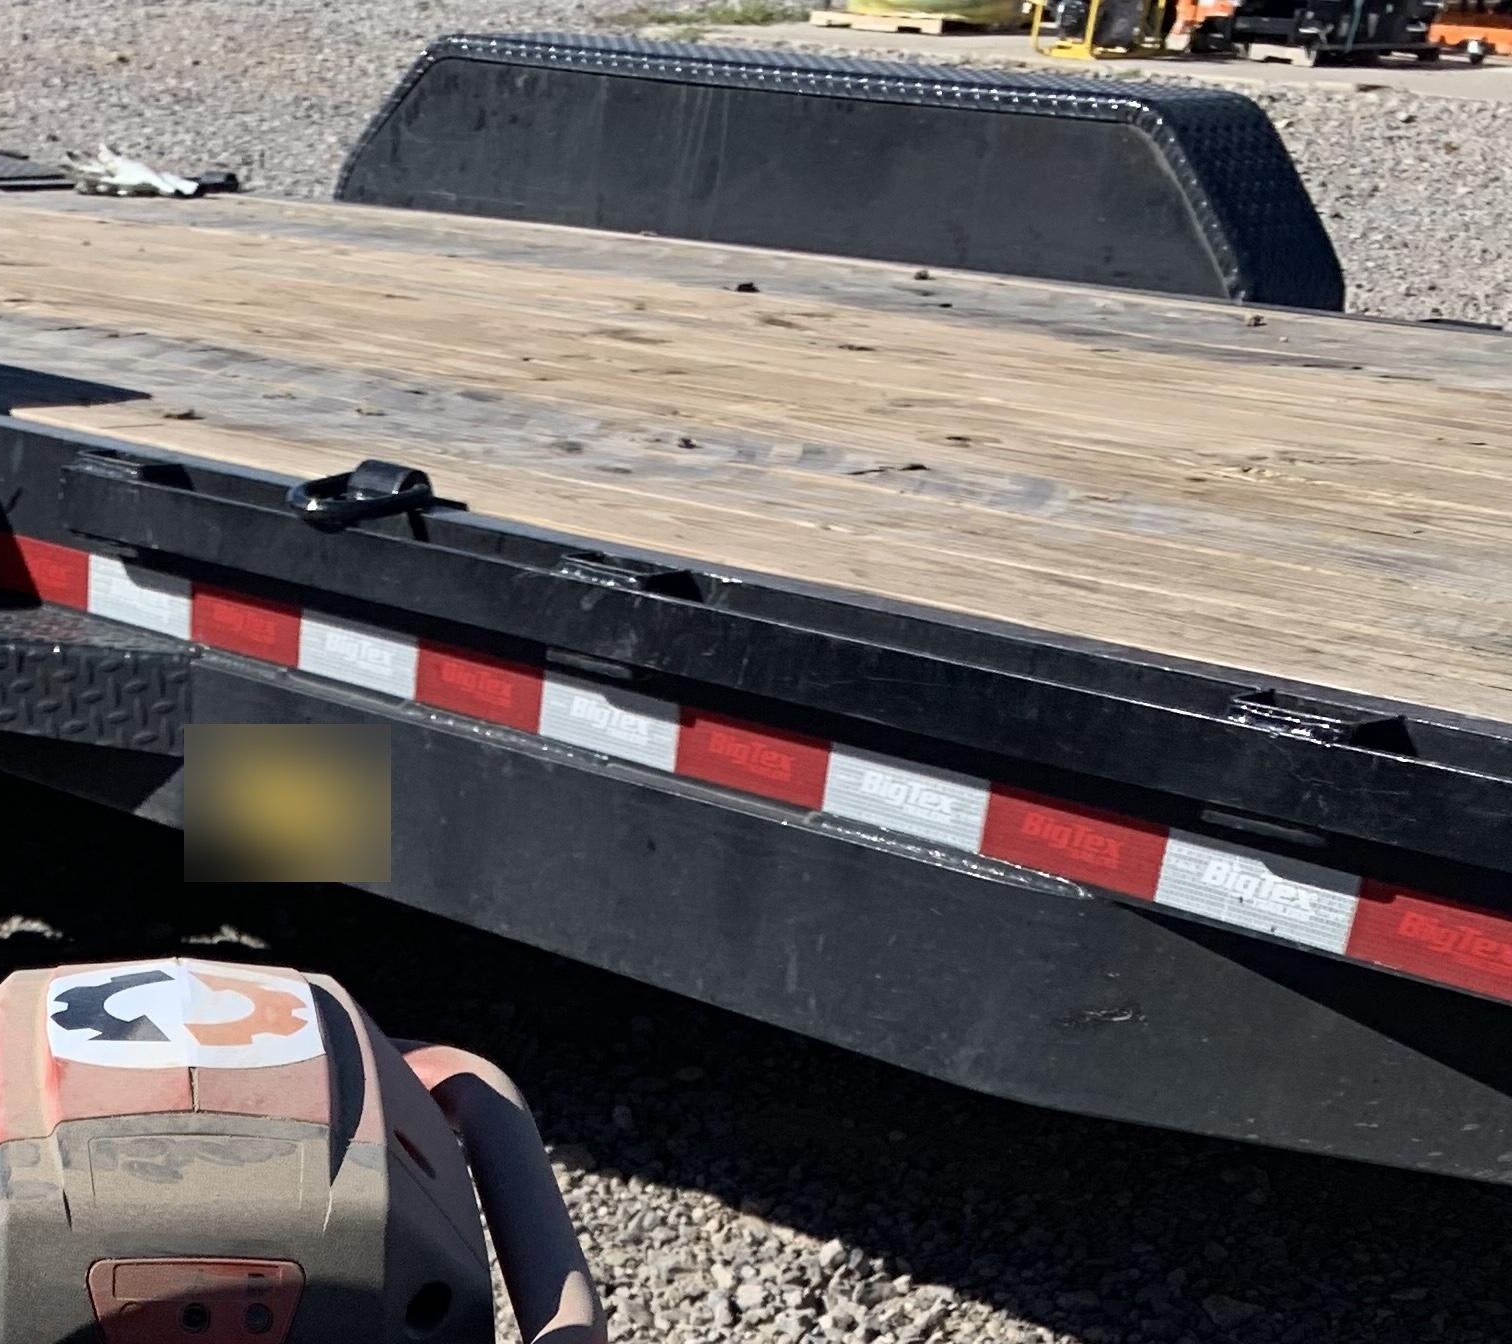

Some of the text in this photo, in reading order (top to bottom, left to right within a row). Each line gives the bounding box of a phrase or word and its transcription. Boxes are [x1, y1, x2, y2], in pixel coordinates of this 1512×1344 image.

[570, 694, 650, 735] BigTex
[708, 731, 794, 770] BigTex
[860, 771, 955, 813] BigTex
[1021, 811, 1123, 856] BigTex
[1200, 859, 1319, 913] BigTex
